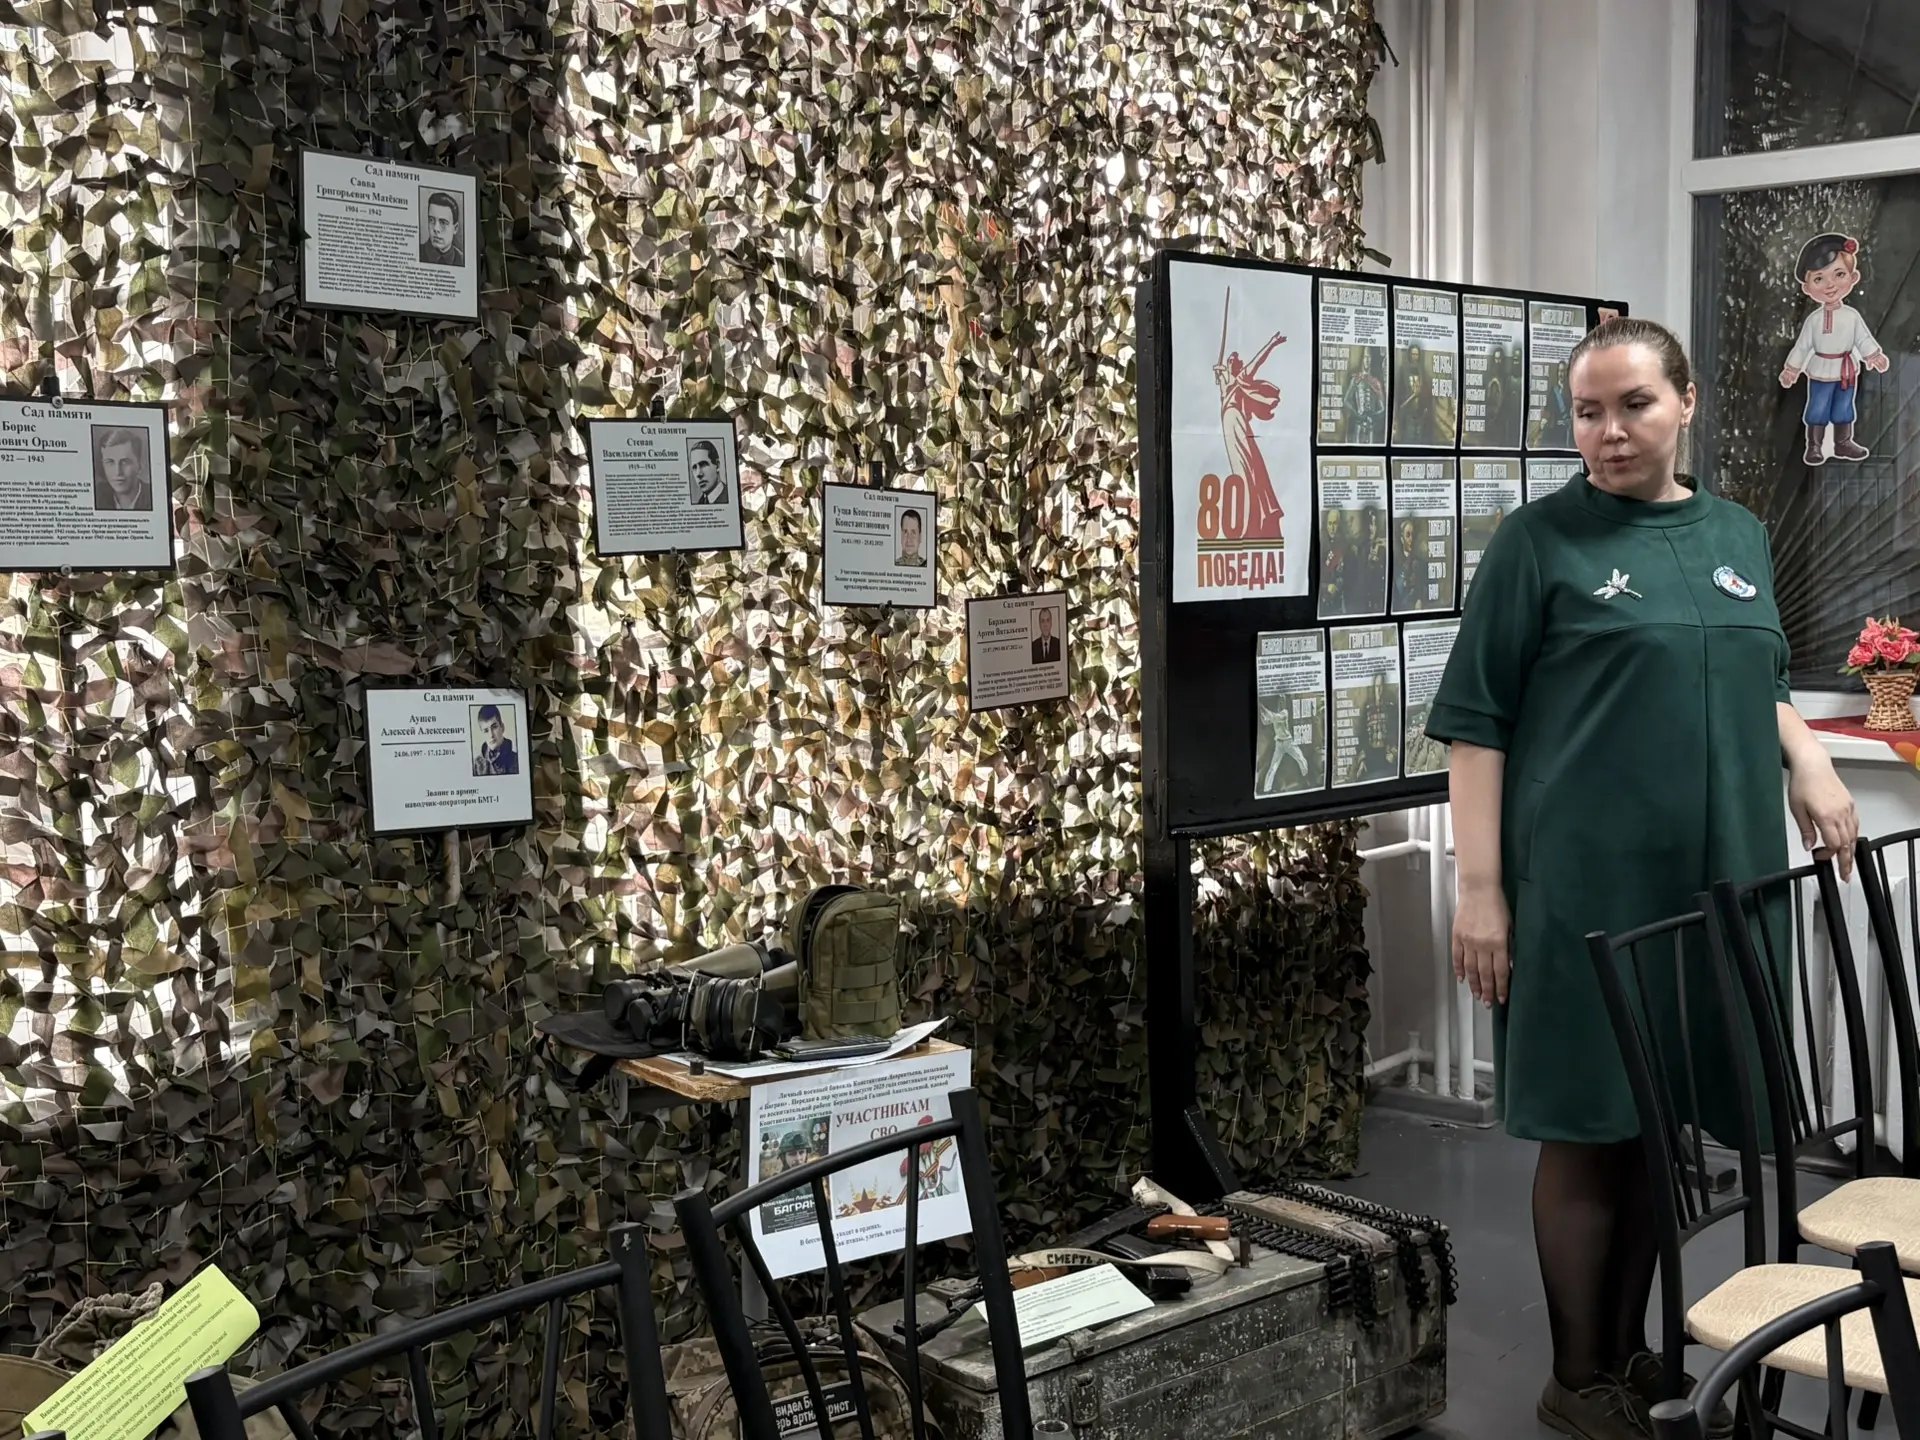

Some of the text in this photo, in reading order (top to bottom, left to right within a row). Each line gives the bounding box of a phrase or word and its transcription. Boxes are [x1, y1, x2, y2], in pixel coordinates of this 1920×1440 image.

[365, 164, 420, 182] Сад памяти
[350, 177, 376, 189] Савва
[21, 405, 93, 420] Сад памяти
[2, 421, 37, 434] Борис
[641, 426, 657, 435] Сад
[32, 437, 67, 450] Орлов
[0, 454, 45, 463] 922 1943
[1197, 474, 1245, 539] 80
[1197, 551, 1285, 590] ПОБЕДА!
[423, 692, 475, 702] Сад памяти
[381, 726, 416, 737] Алексей
[836, 1098, 929, 1127] УЧАСТНИКАМ
[1046, 1253, 1093, 1265] СМЕРТЬ
